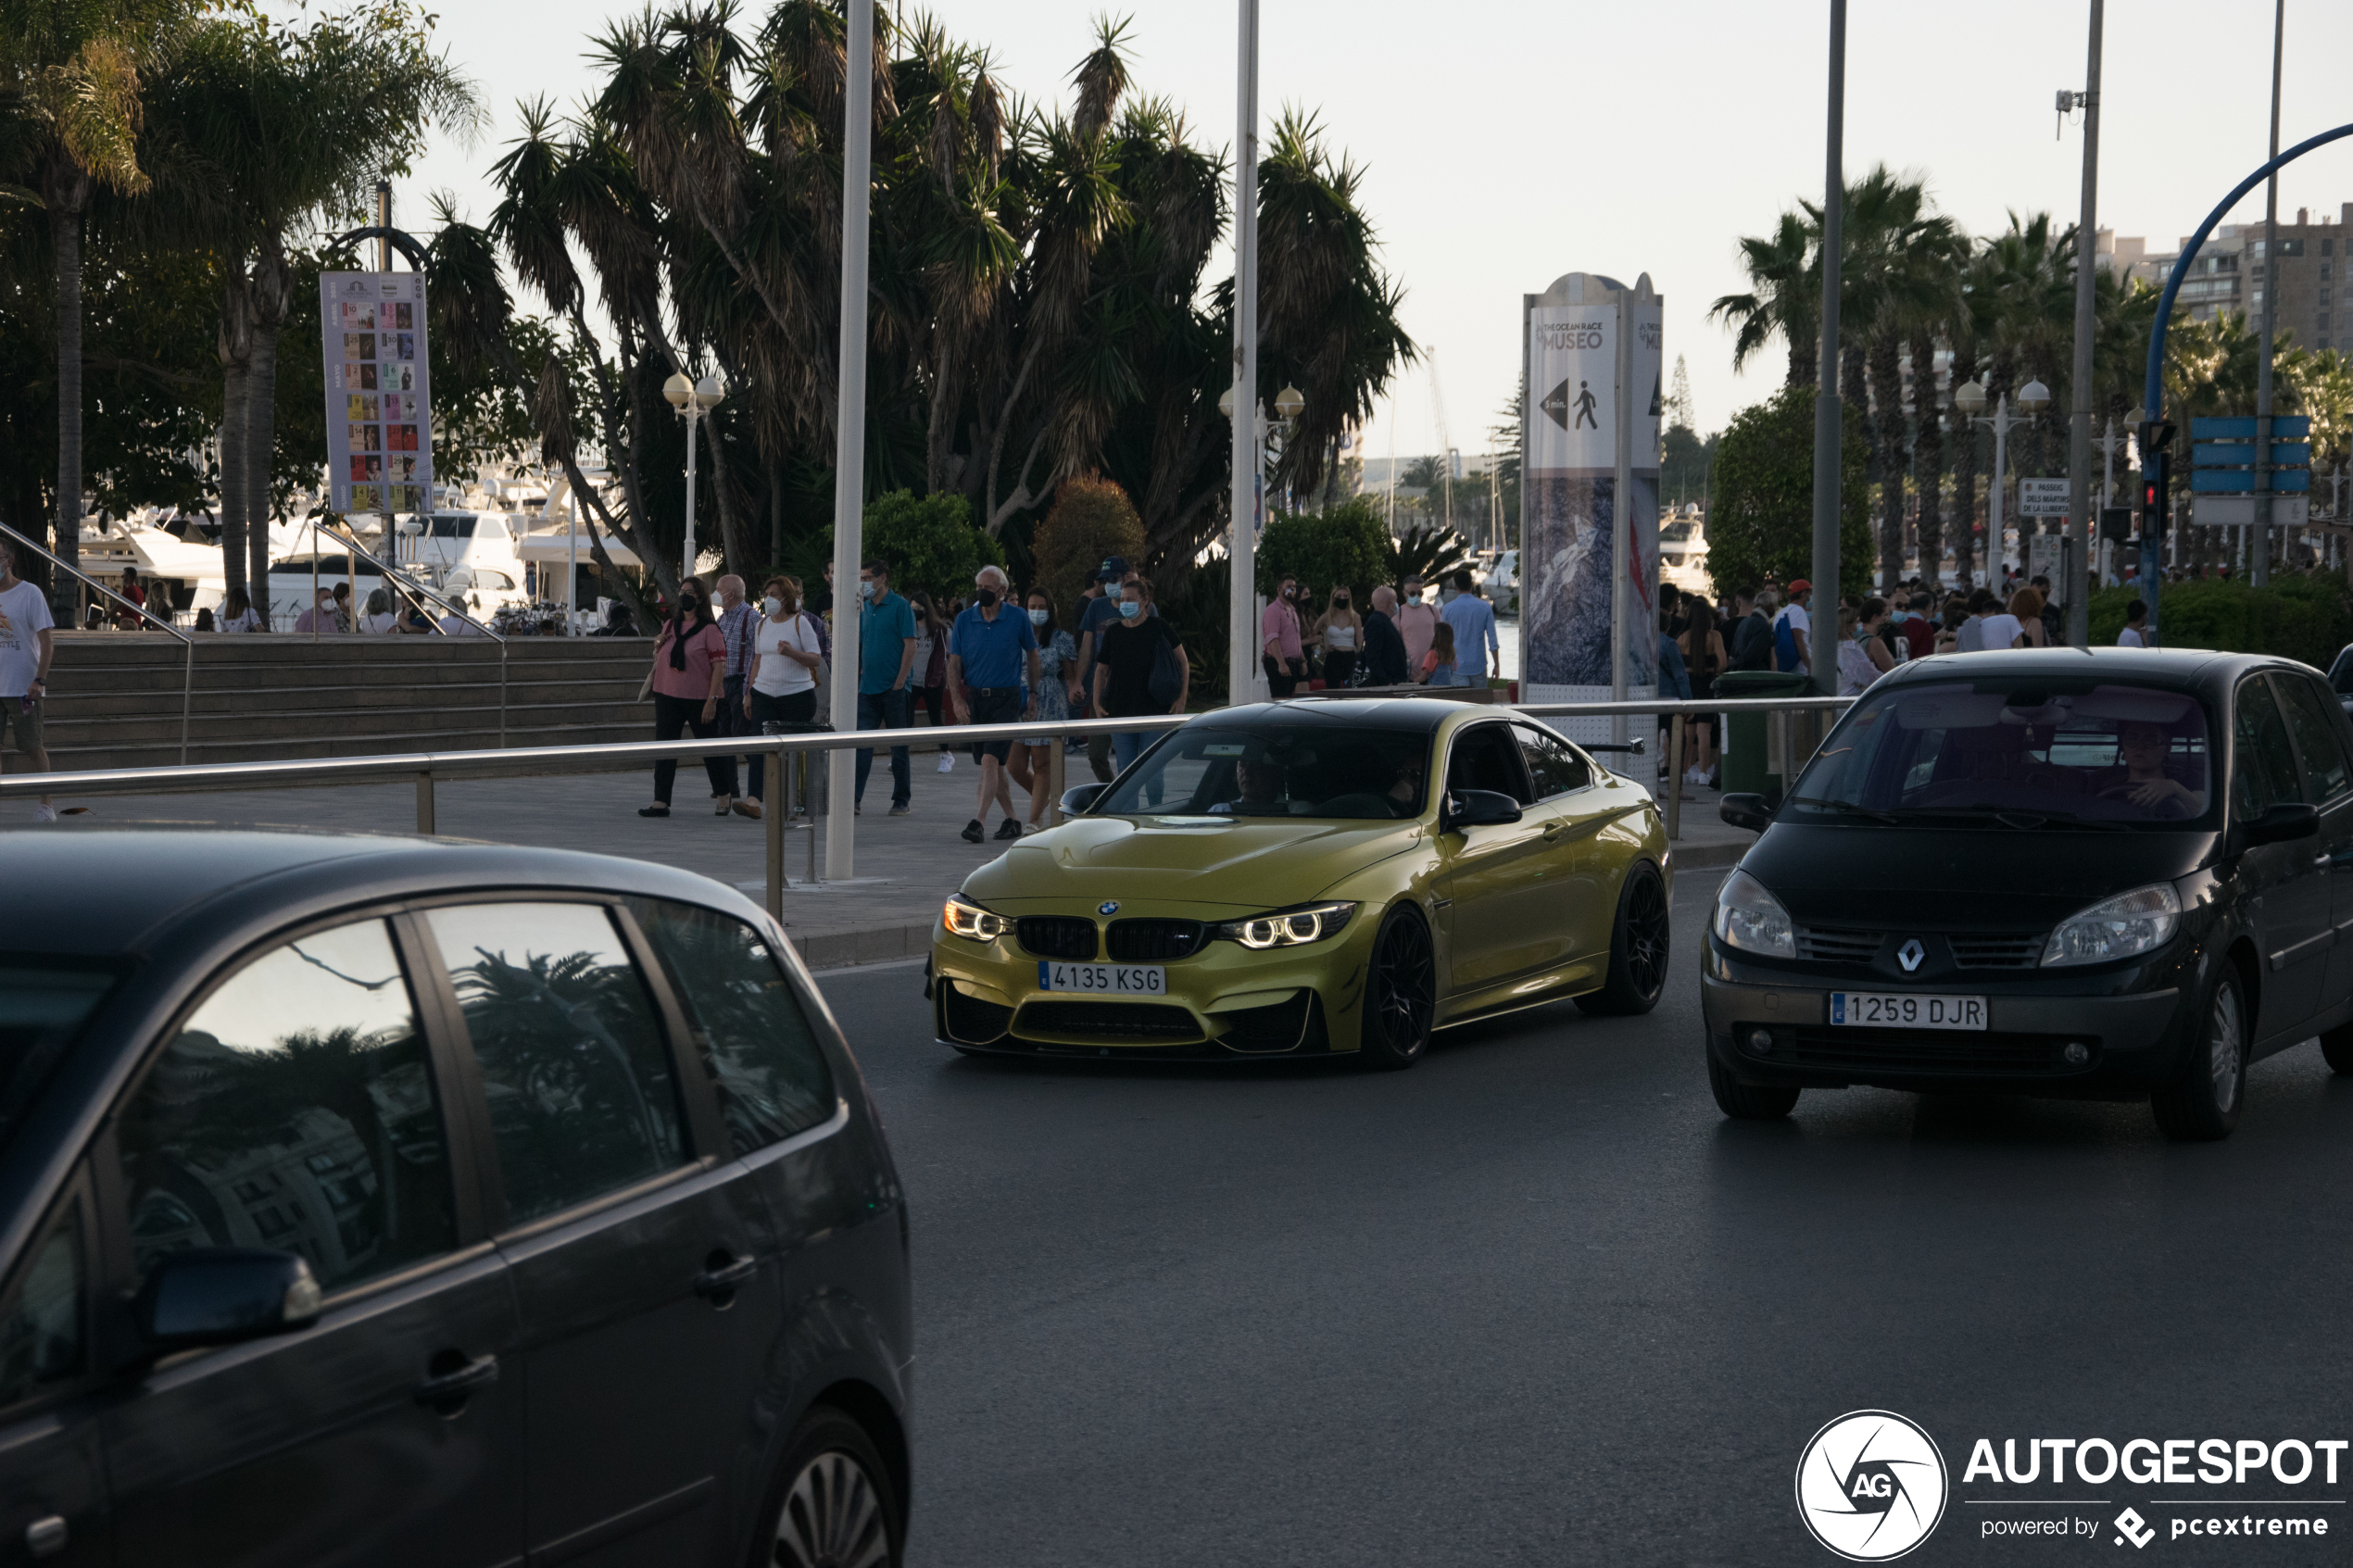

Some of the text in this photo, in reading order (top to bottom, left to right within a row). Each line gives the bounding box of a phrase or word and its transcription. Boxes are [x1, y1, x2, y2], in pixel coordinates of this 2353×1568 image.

[1543, 332, 1603, 350] MUSEO
[1545, 399, 1567, 408] 5 min.
[2027, 495, 2042, 503] DELS
[1055, 966, 1159, 990] 4135 KSG
[1853, 997, 1981, 1024] 1259 DJR
